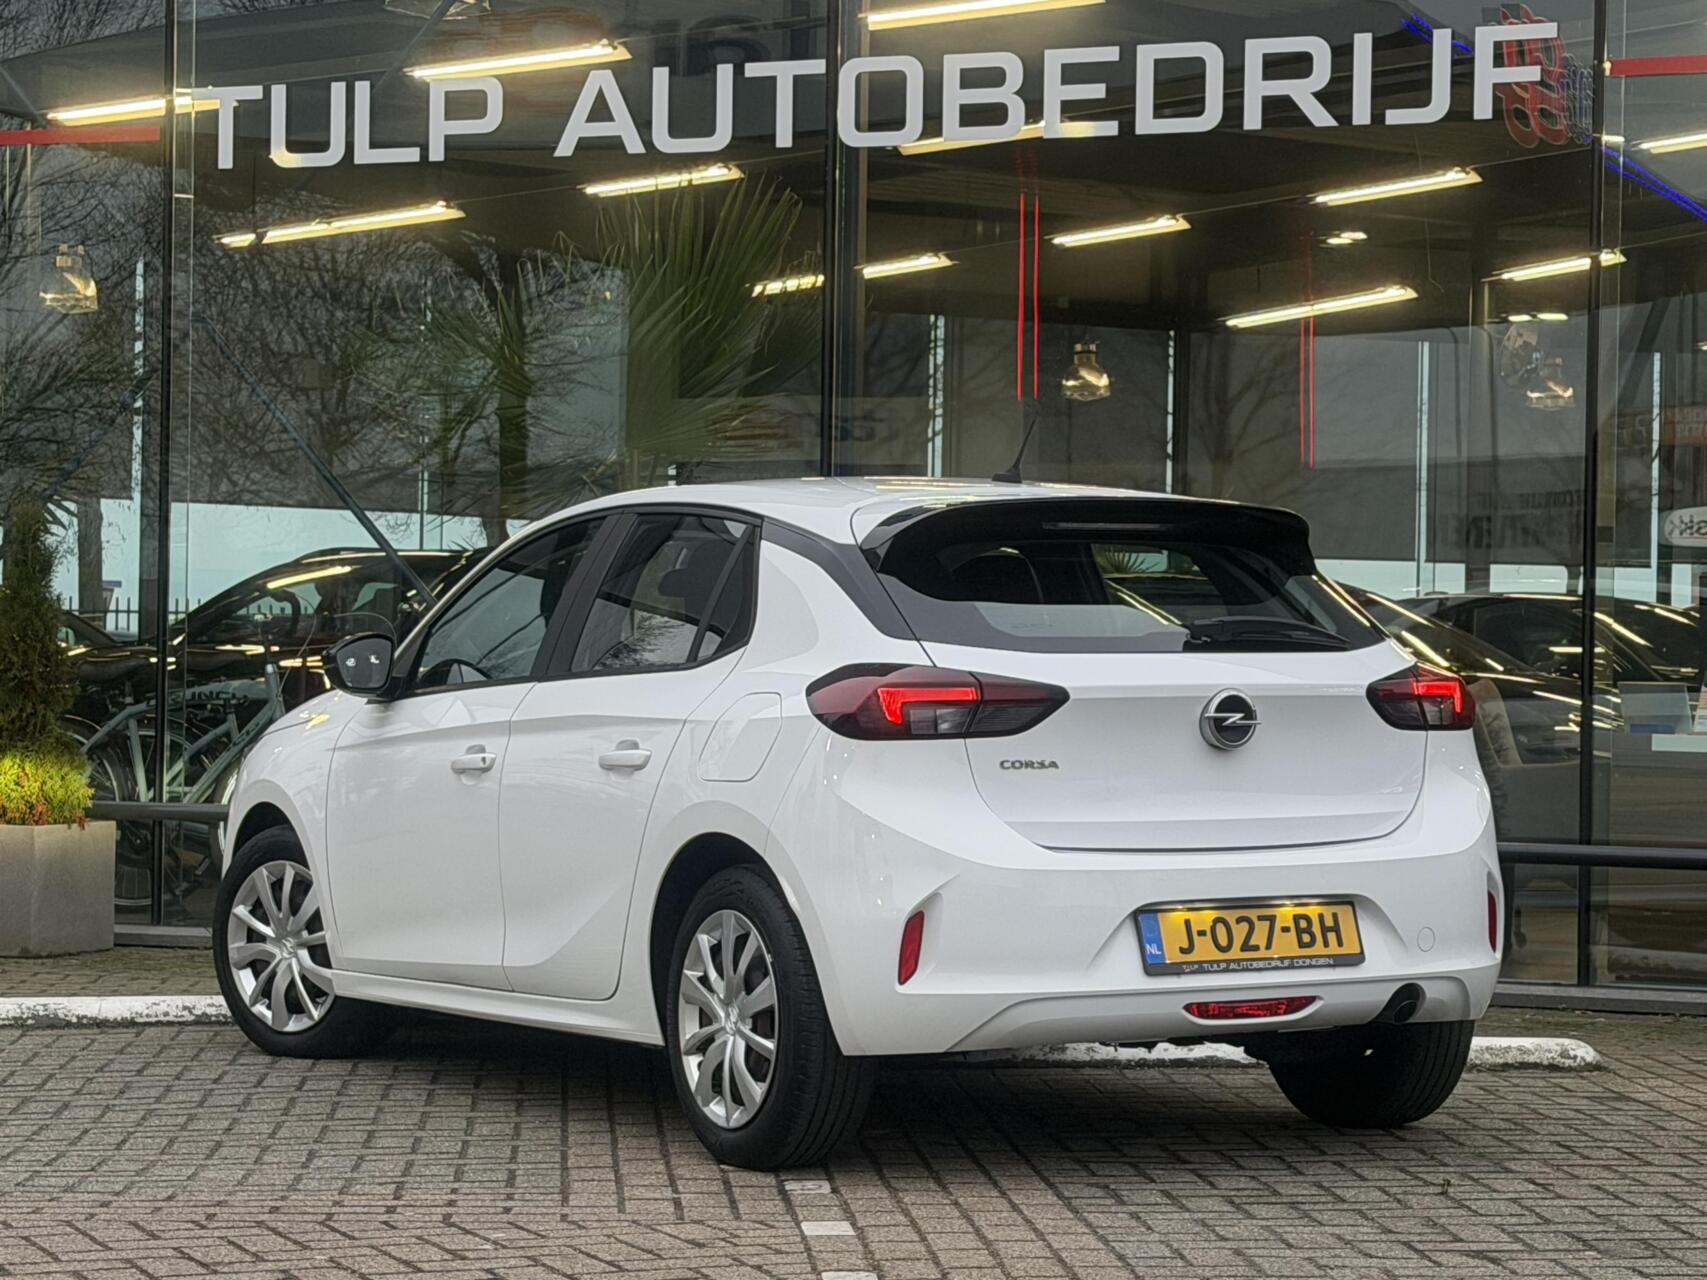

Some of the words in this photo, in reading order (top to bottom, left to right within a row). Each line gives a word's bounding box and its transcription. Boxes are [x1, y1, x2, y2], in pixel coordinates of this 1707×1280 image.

[194, 77, 502, 170] TULP
[554, 22, 1559, 158] AUTOBEDRIJF
[999, 759, 1060, 770] CORSA
[1179, 912, 1344, 955] J-027-BH
[1145, 943, 1162, 956] NL
[1202, 963, 1227, 971] TULP
[1229, 959, 1291, 970] AUTOBEDRIJF
[1293, 957, 1334, 967] DONGEN
